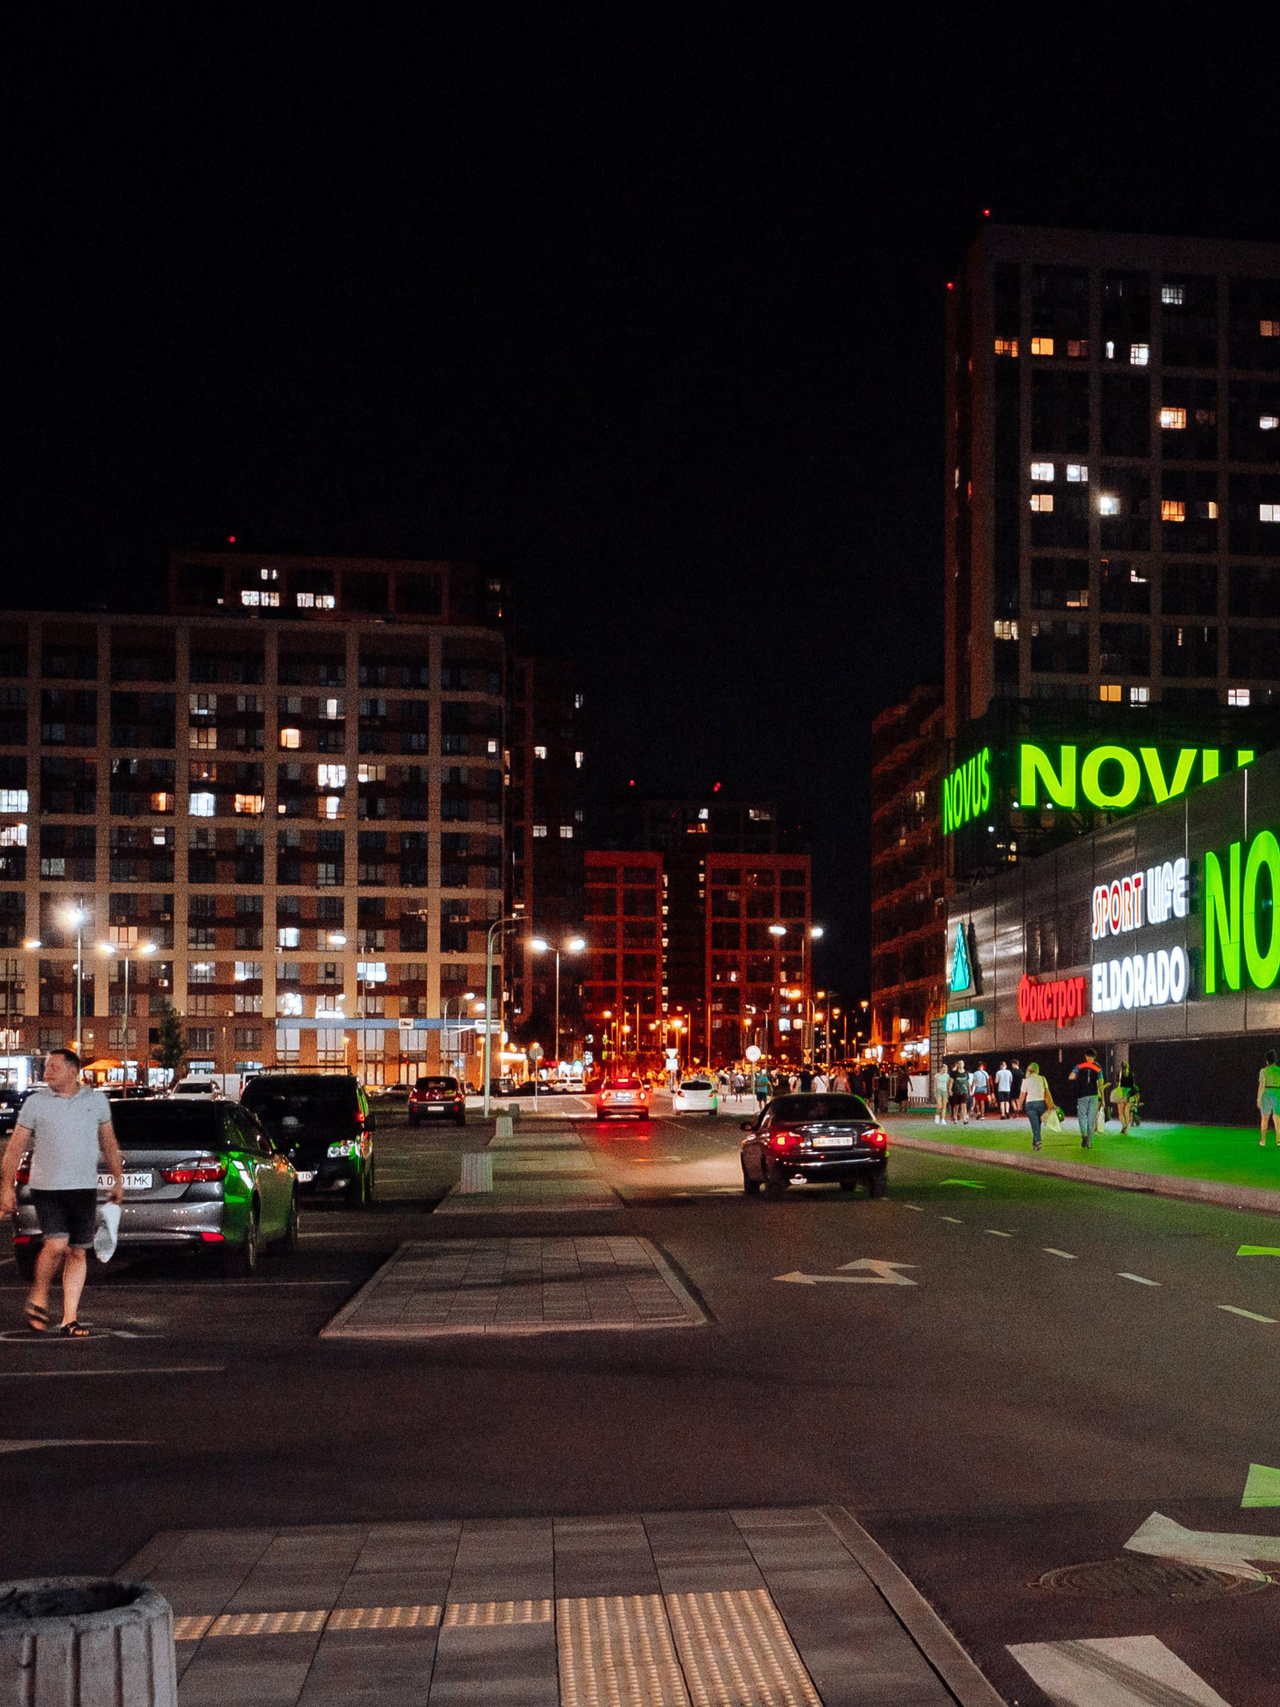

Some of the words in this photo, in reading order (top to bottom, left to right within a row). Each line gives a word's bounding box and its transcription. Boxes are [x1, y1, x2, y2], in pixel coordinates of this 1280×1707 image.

[943, 747, 990, 835] NOVUS
[1092, 871, 1144, 940] SPORT
[1147, 857, 1188, 924] LIFE
[1018, 973, 1086, 1028] Фокстрот
[1092, 946, 1188, 1013] ELDORADO
